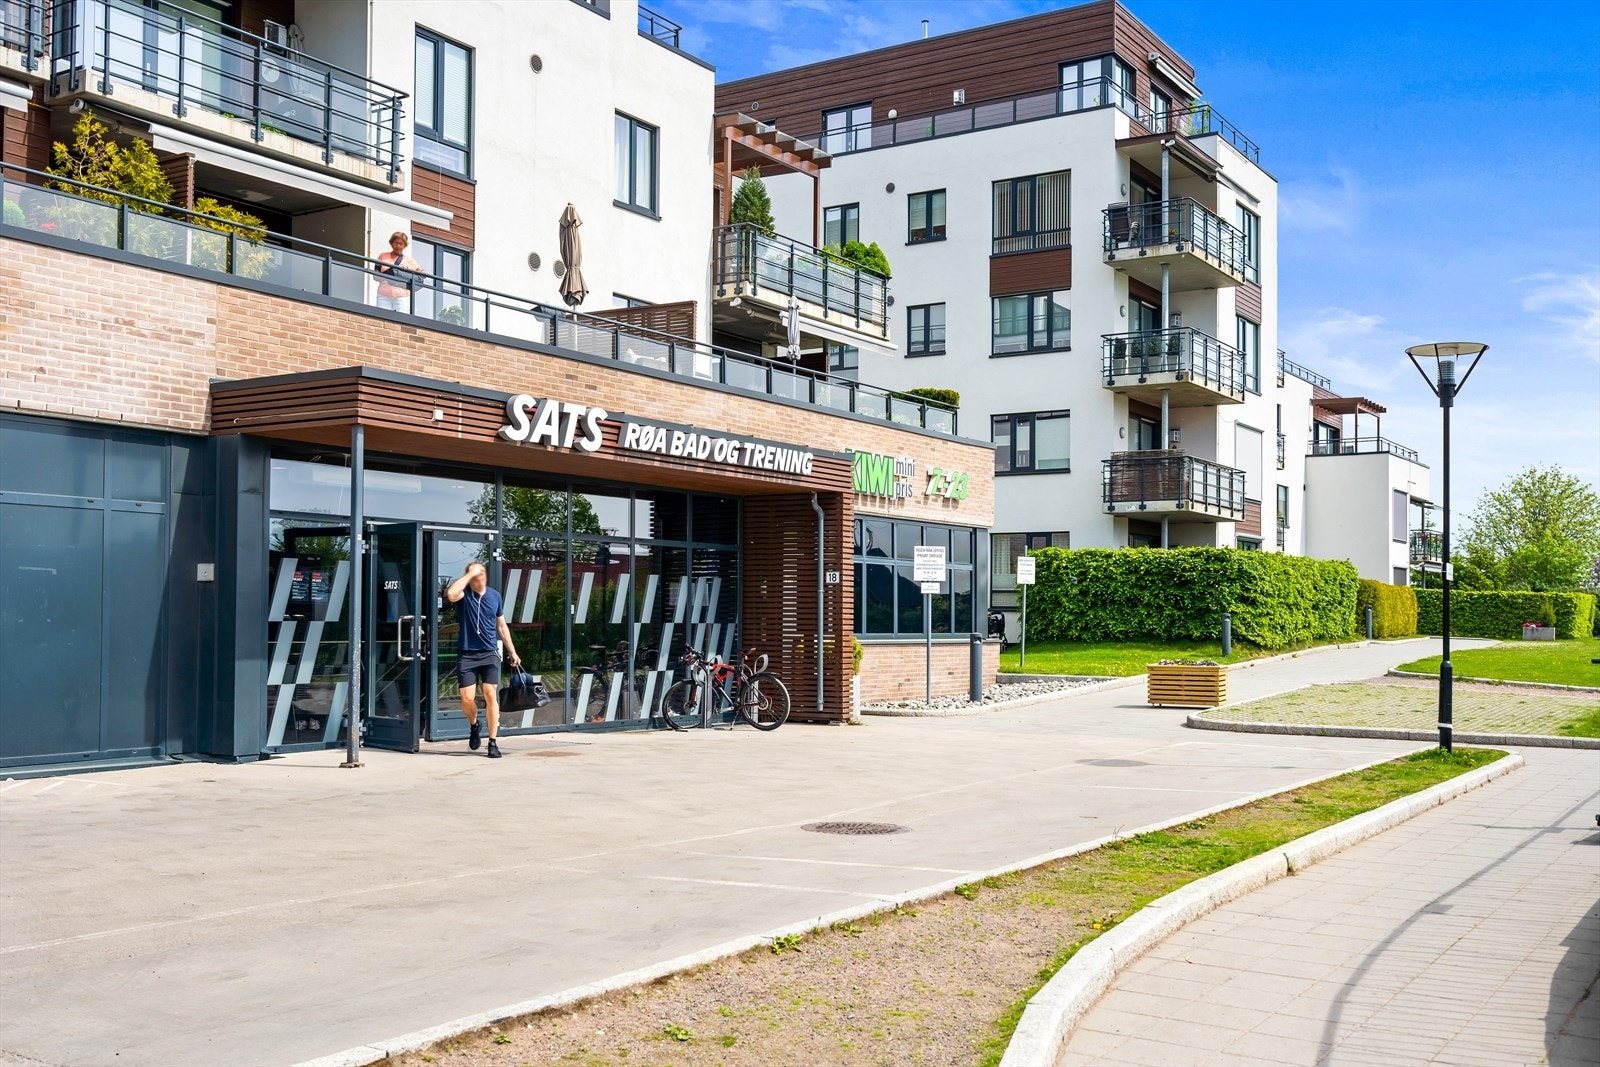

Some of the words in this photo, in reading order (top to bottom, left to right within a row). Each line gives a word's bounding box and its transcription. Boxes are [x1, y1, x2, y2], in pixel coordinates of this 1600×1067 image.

[500, 394, 608, 452] SATS
[624, 423, 667, 453] RØA
[671, 430, 711, 459] BAD
[713, 438, 740, 465] OG
[743, 443, 813, 475] TRENING
[895, 457, 915, 477] mini
[895, 479, 913, 499] pris
[931, 467, 968, 500] 7-23
[384, 581, 398, 590] SATS
[829, 573, 837, 582] 18
